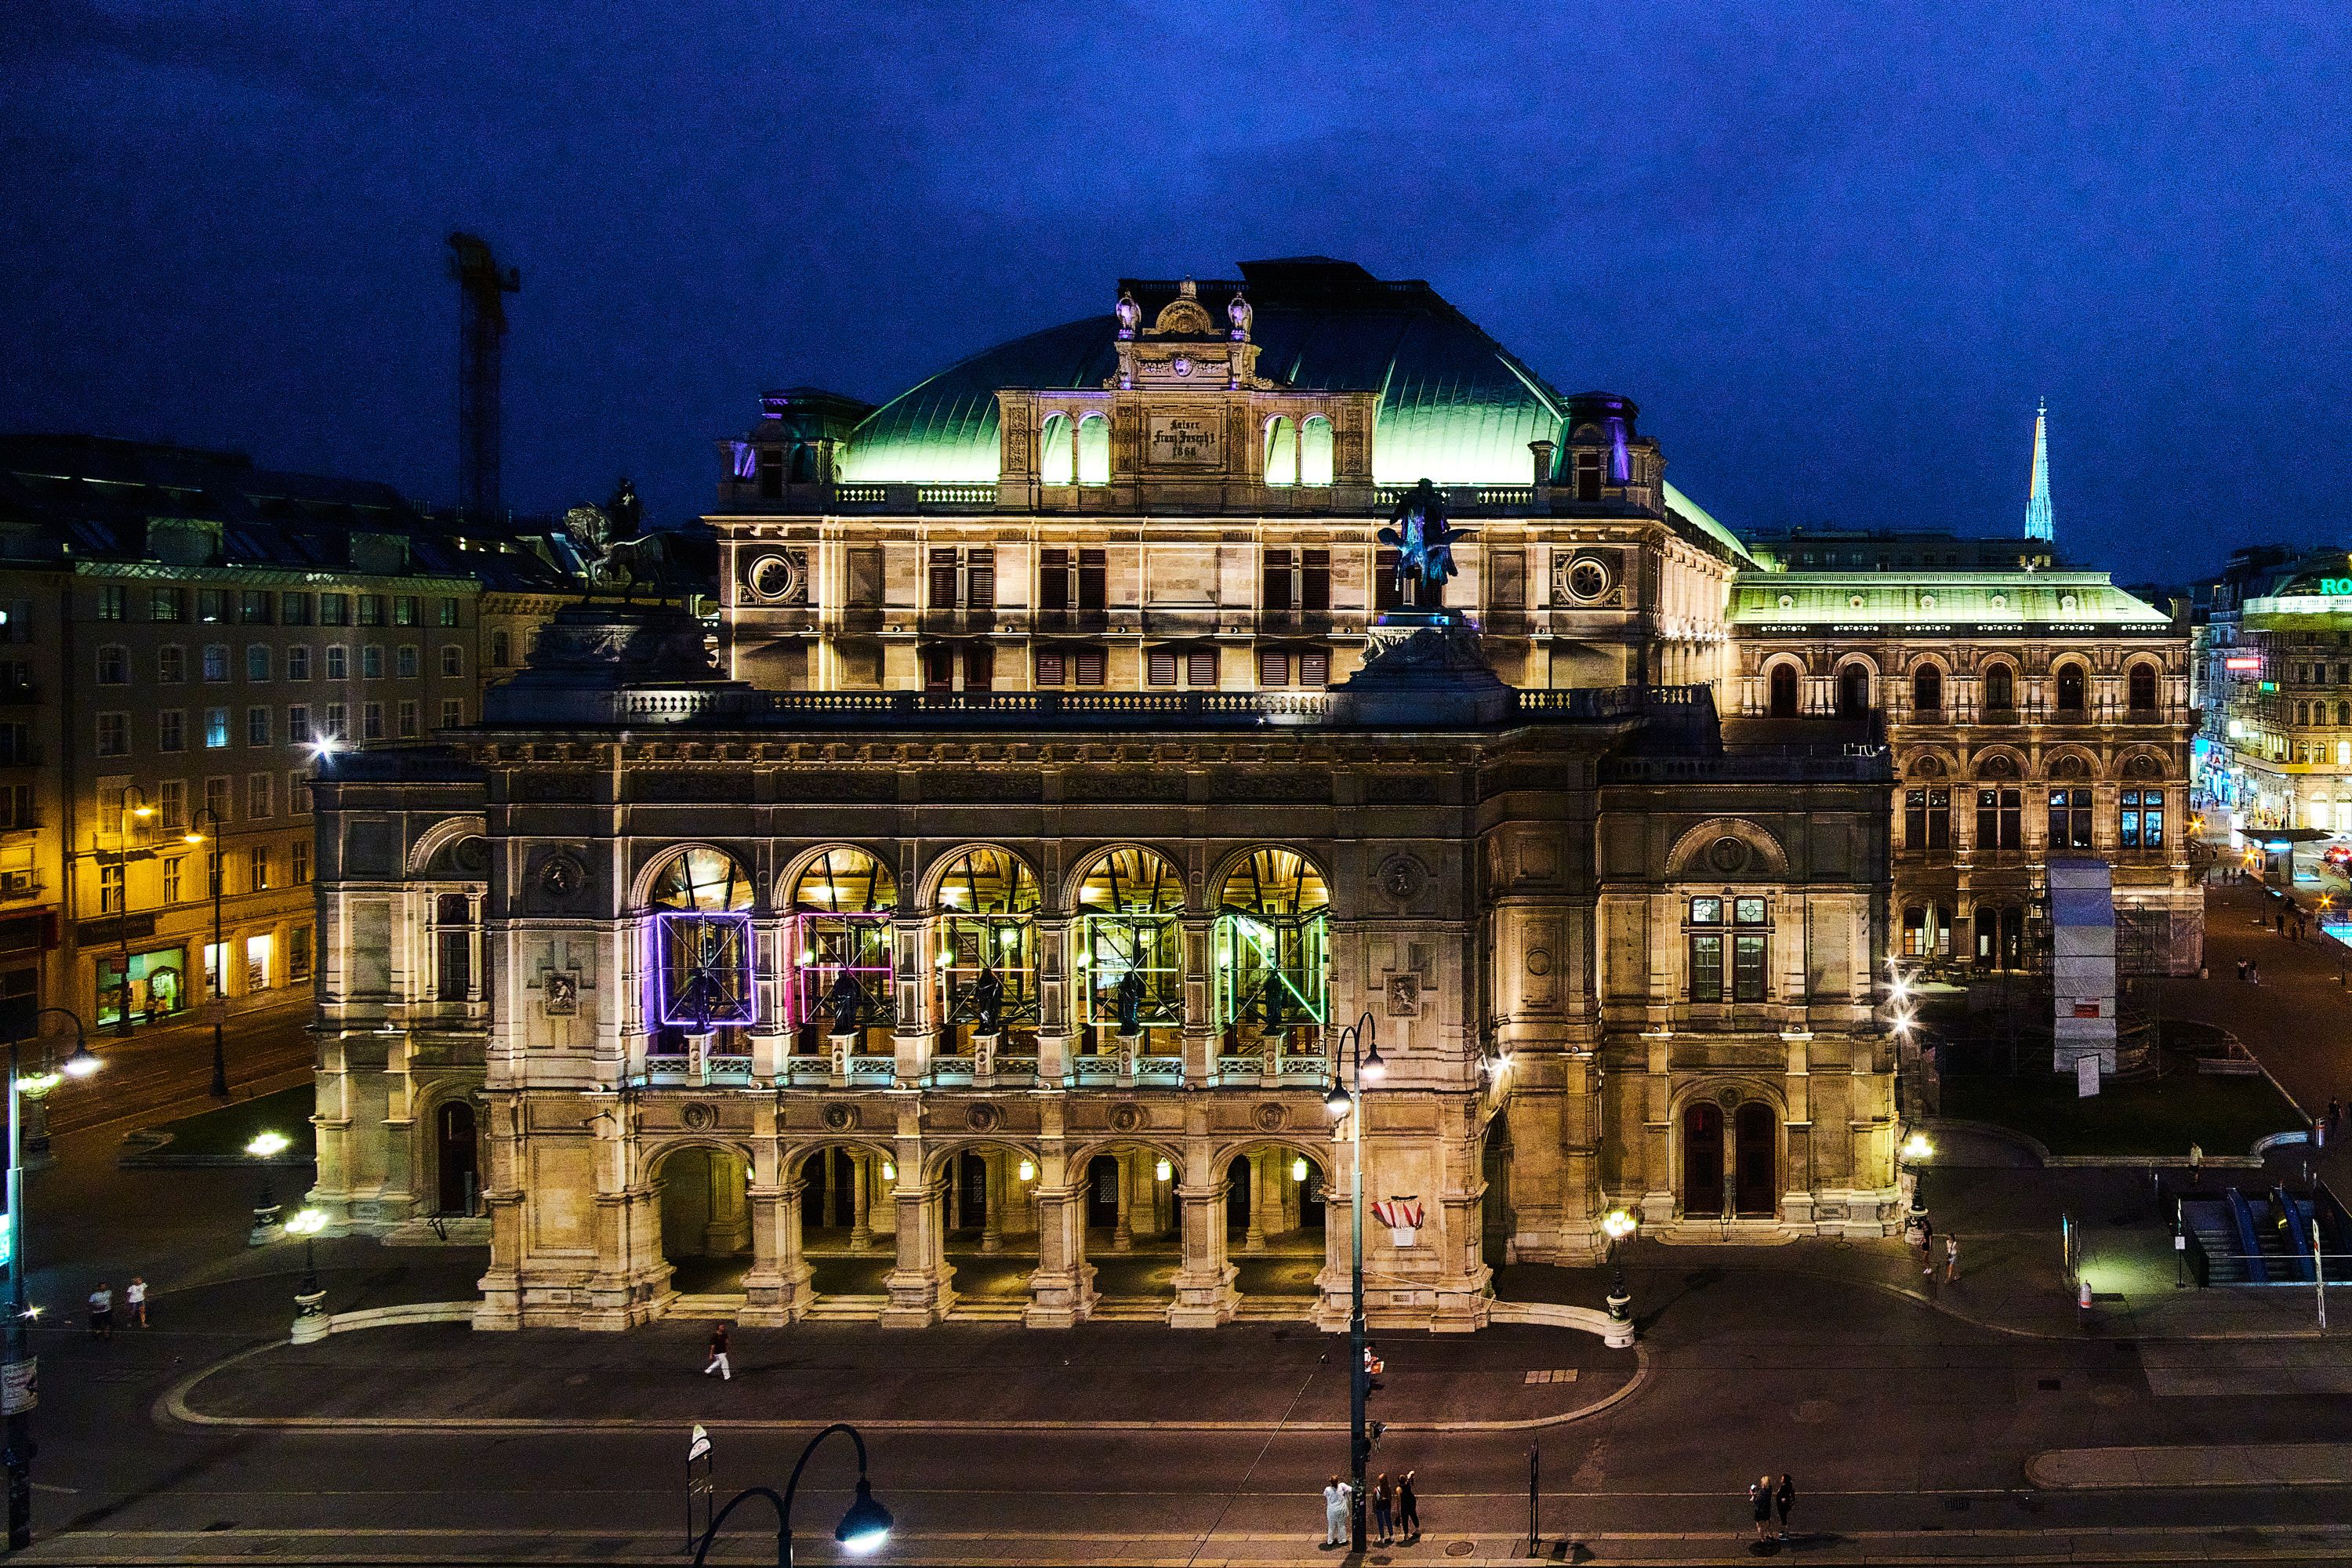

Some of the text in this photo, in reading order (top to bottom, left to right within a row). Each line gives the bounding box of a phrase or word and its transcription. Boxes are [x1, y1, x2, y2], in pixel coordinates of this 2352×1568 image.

[1171, 419, 1200, 430] Kaiser
[1152, 430, 1178, 446] Franz
[1178, 430, 1209, 446] Joseph
[2320, 578, 2352, 594] RO
